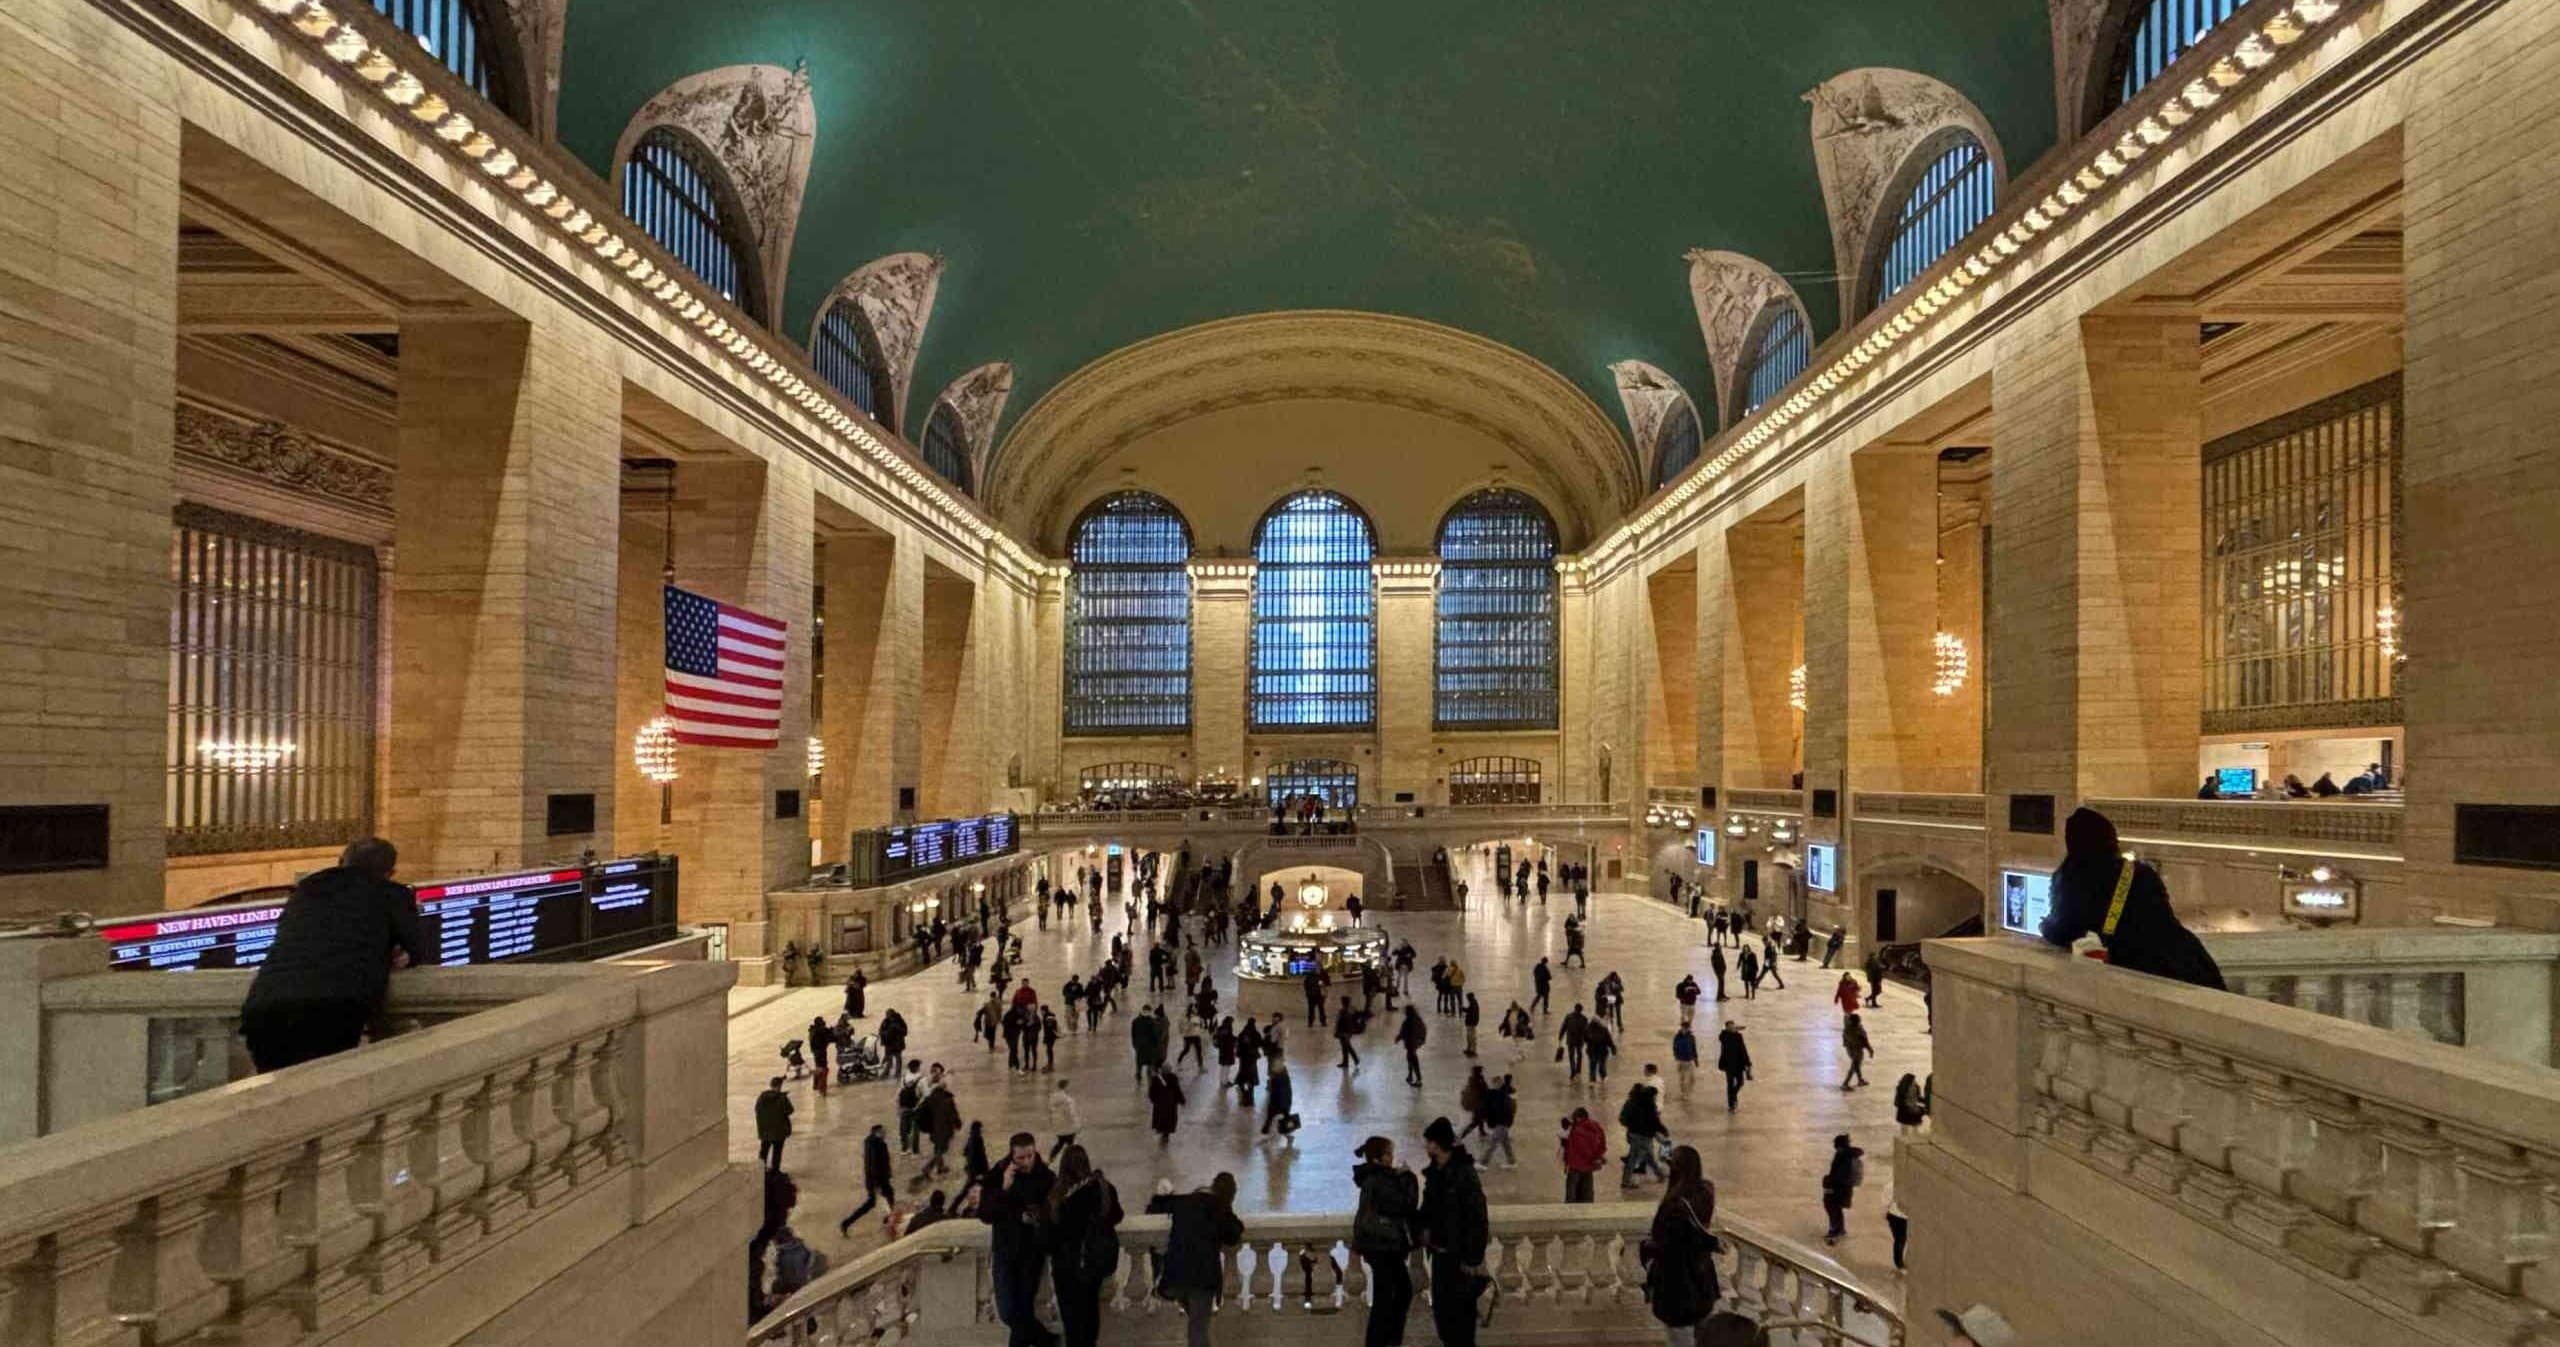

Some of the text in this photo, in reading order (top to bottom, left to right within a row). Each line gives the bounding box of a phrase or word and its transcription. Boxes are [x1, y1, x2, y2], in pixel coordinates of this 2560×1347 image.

[157, 920, 191, 935] NEW
[192, 913, 239, 930] HAVEN
[239, 911, 269, 924] LINE
